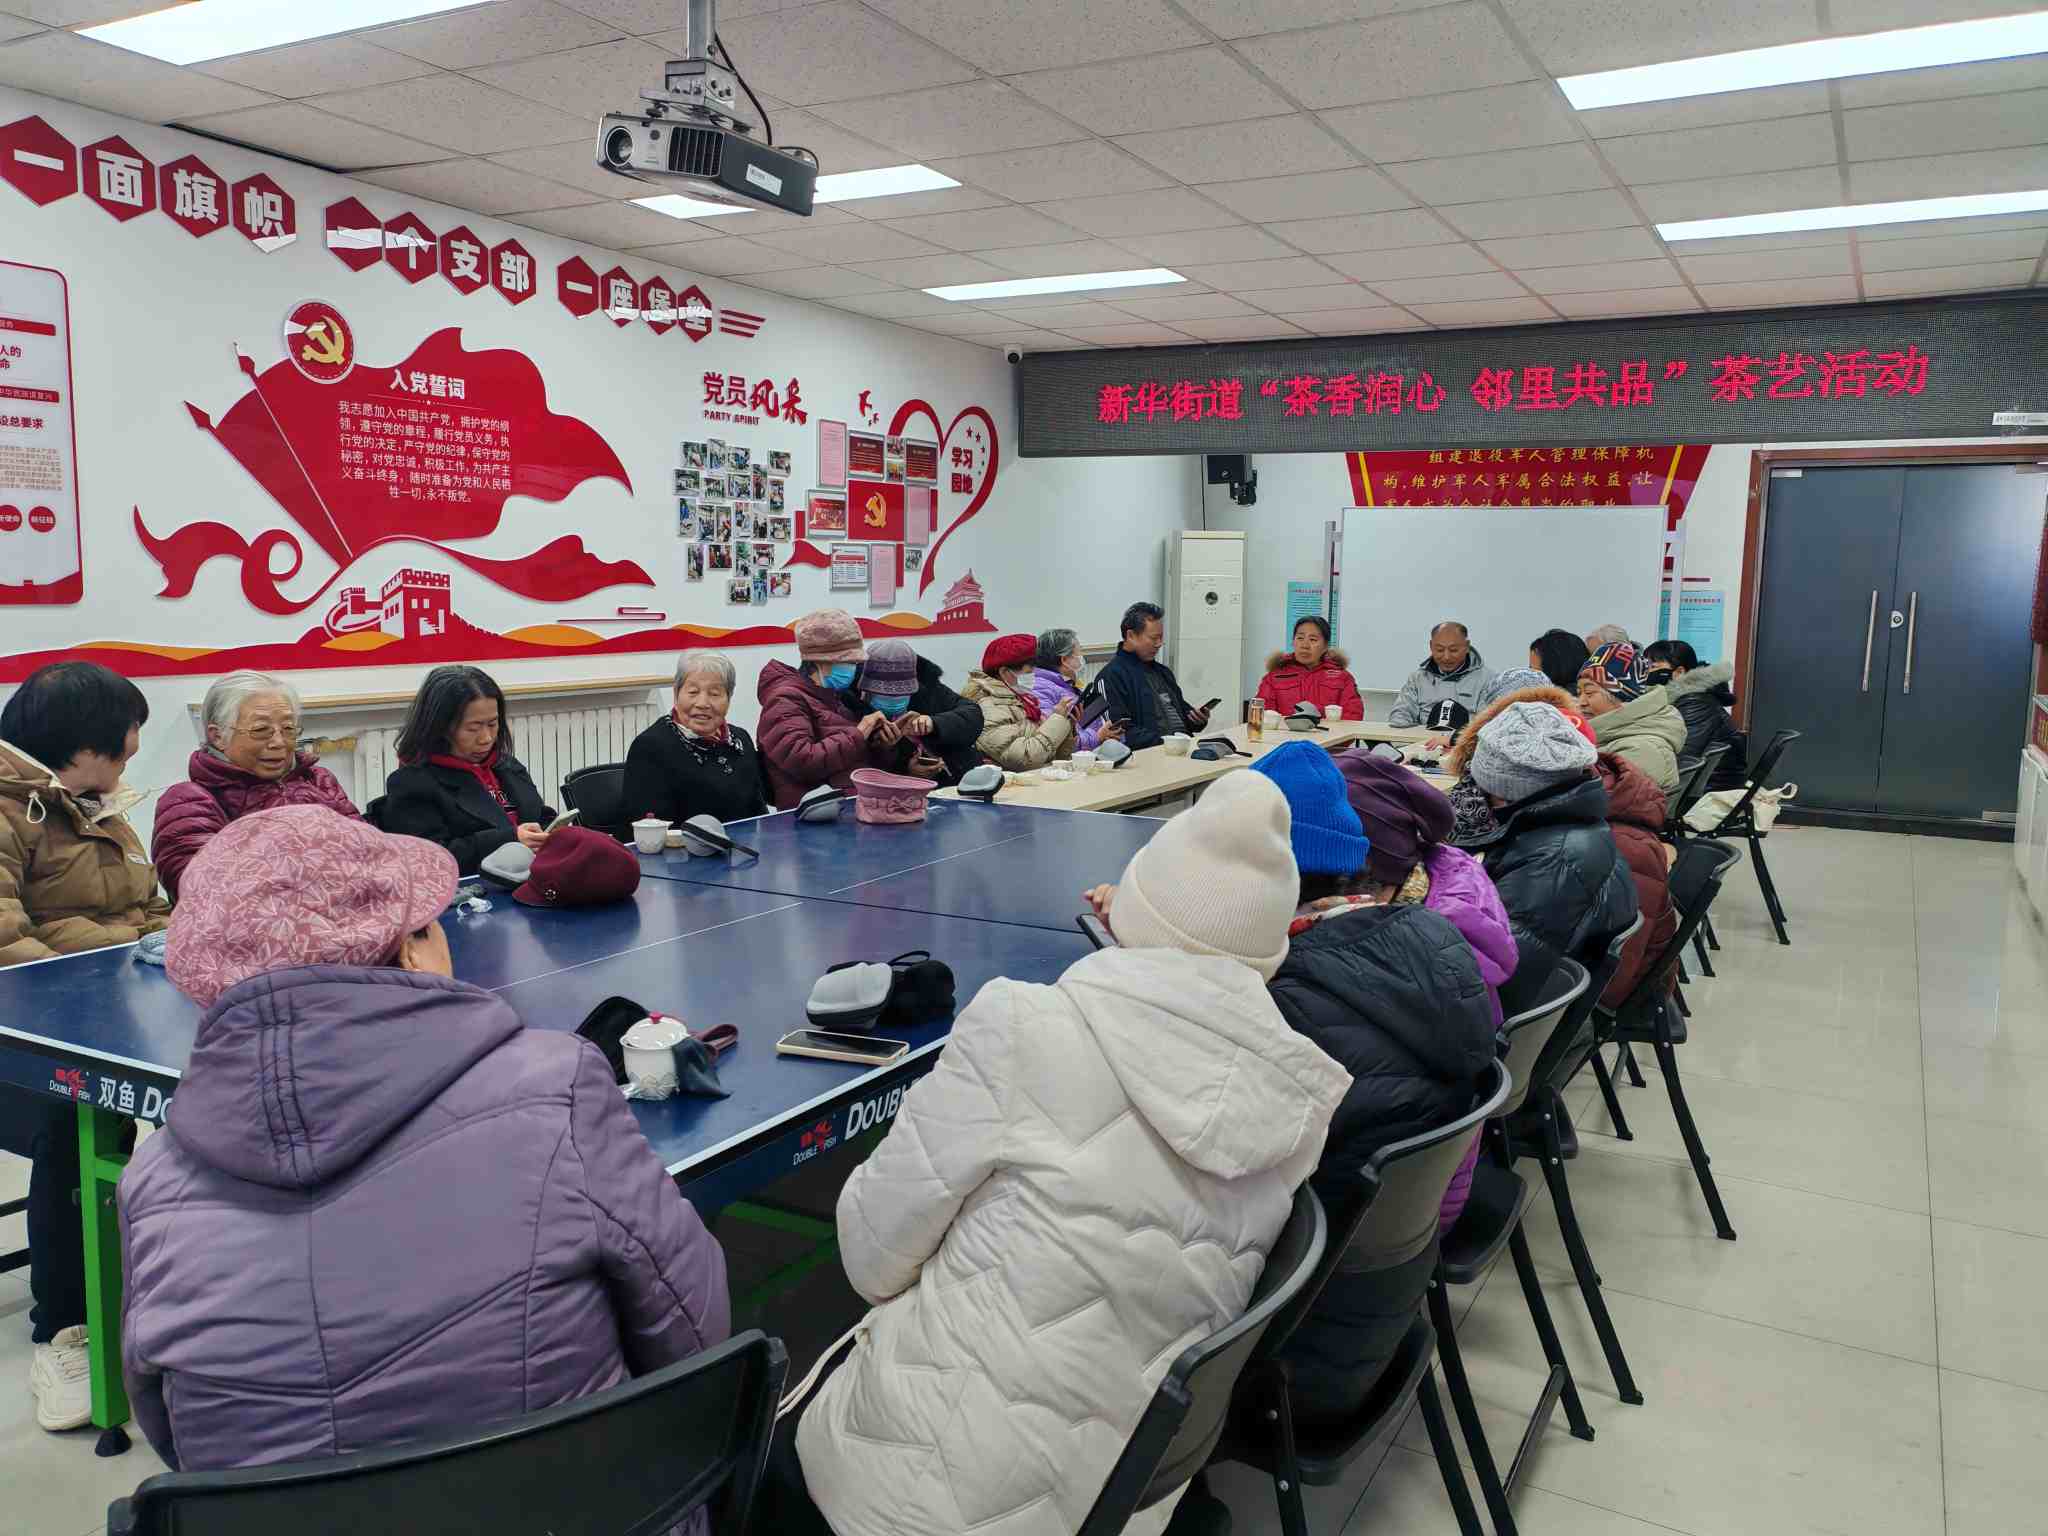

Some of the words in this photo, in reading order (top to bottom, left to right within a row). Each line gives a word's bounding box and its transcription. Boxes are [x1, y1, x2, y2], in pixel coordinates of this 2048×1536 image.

[13, 148, 285, 239] 一面旗帜
[336, 225, 530, 293] 一个支部
[566, 278, 708, 332] 一座堡垒
[390, 368, 465, 400] 入党誓词
[703, 371, 808, 426] 党员风采
[704, 410, 732, 421] PARTY
[734, 414, 760, 426] SPIRIT
[49, 1080, 73, 1097] DOUBLE
[98, 1076, 136, 1115] 双鱼
[792, 1144, 817, 1166] DOUBLE
